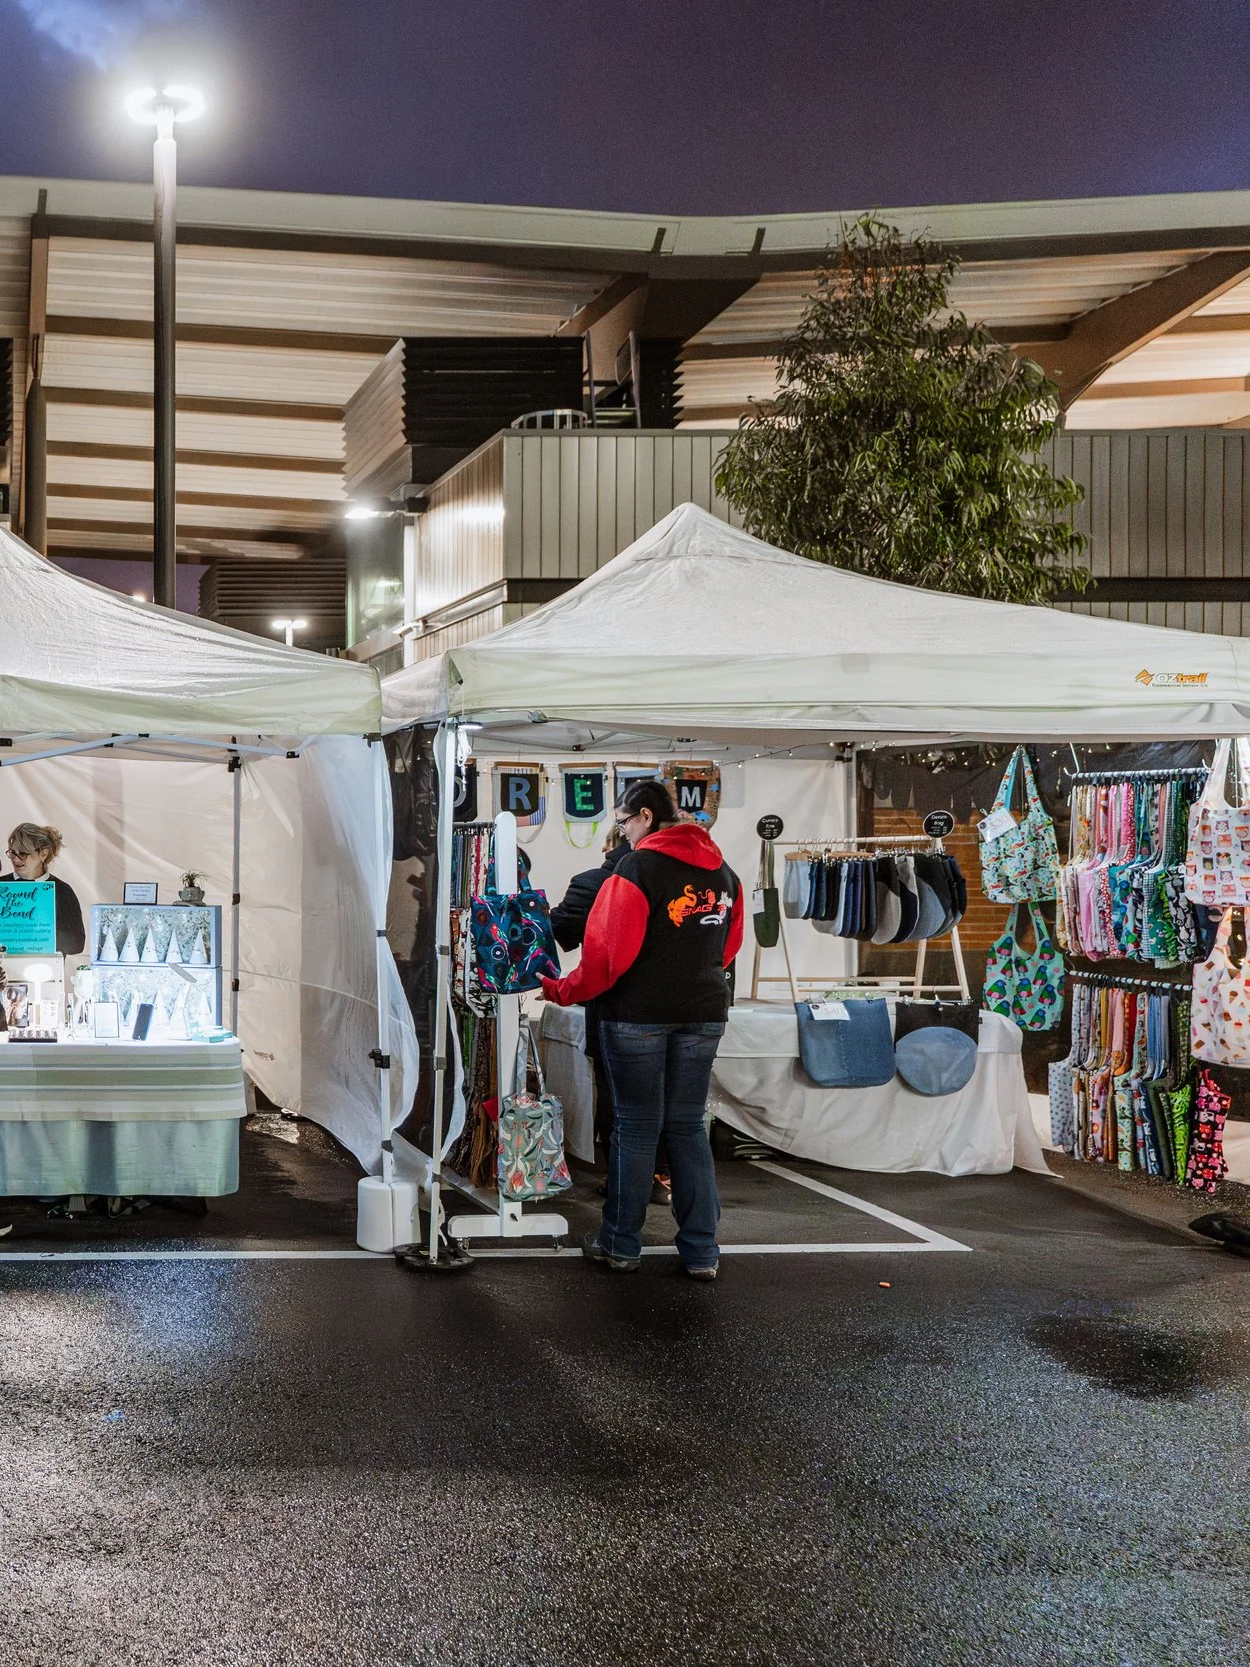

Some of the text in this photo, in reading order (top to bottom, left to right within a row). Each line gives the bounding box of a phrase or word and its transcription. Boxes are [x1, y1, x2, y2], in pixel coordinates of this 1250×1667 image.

[508, 776, 701, 811] R E M
[6, 899, 24, 908] the
